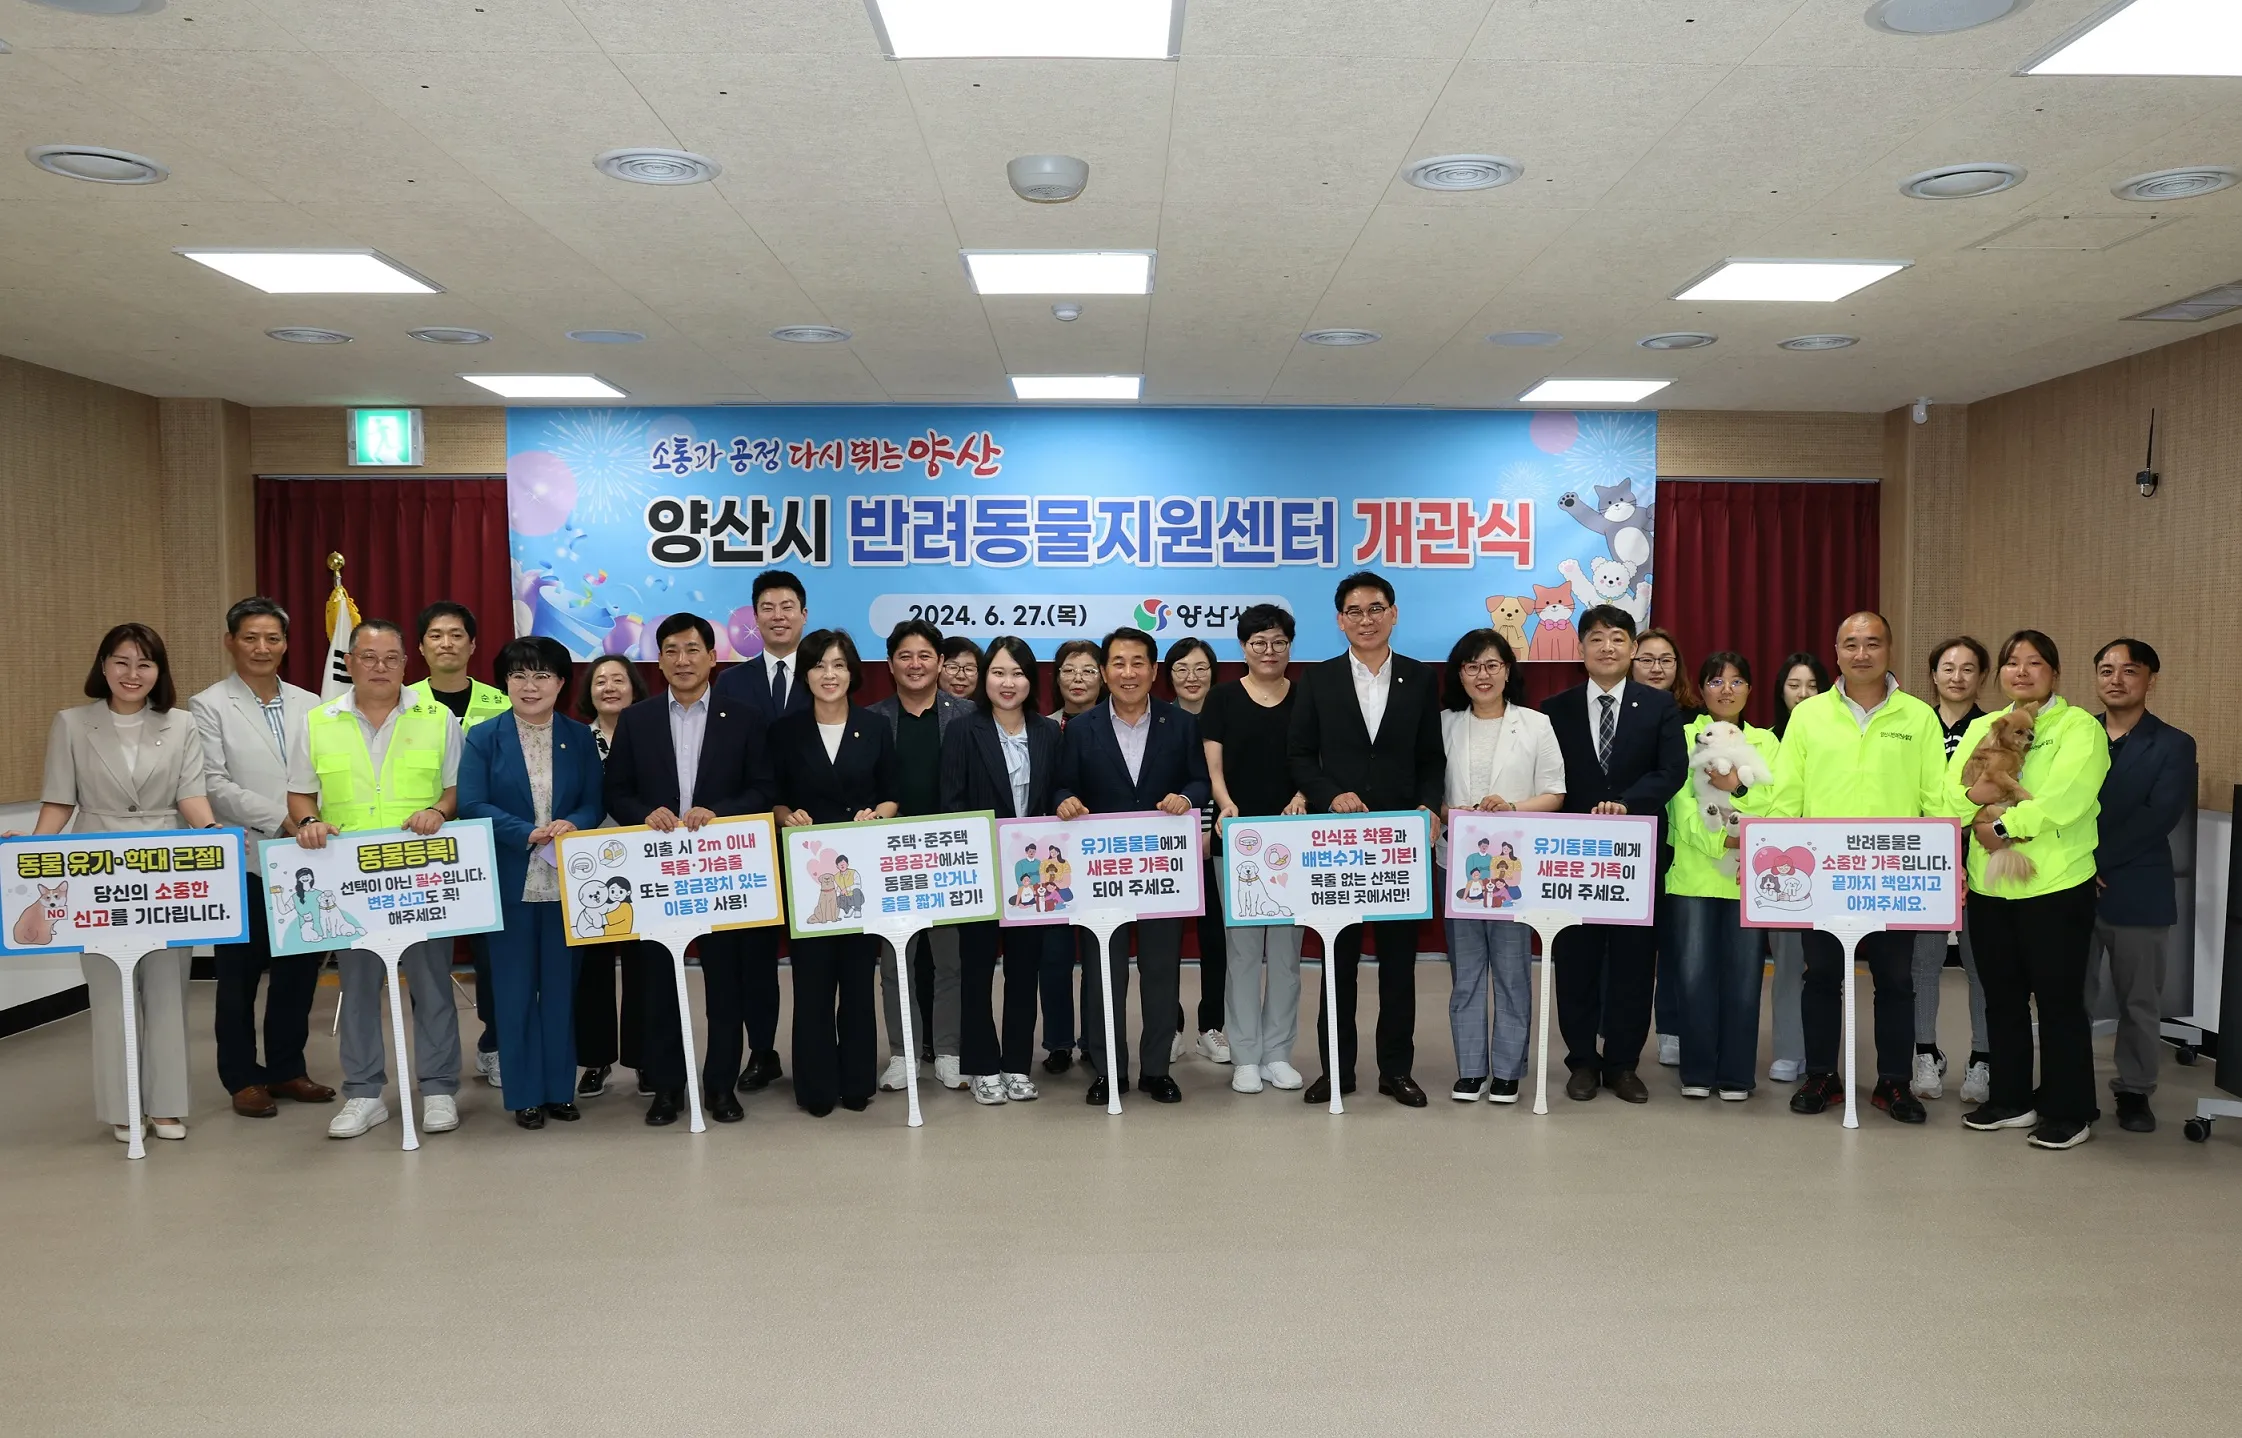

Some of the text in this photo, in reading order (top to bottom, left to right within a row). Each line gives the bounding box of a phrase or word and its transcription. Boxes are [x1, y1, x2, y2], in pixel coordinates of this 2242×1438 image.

[652, 429, 1001, 479] 소통과 공정 다시 뛰는 양산
[647, 498, 1534, 567] 양산시 반려동물지원센터 개관식
[909, 604, 1087, 628] 2024. 6. 27.(목)
[644, 833, 756, 858] 외출 시 2m 이내
[887, 829, 968, 850] 주택·준주택
[1081, 834, 1187, 855] 유기동물들에게
[1311, 827, 1407, 847] 인식표 착용과
[1534, 837, 1641, 858] 유기동물들에게
[1847, 834, 1921, 851] 반려동물은
[18, 846, 224, 878] 동물 유기·학대 근절!
[357, 837, 459, 873] 동물등록!
[661, 854, 743, 876] 목줄·가슴줄
[879, 851, 978, 872] 공용공간에서는
[1301, 847, 1417, 868] 배변수거는 기본!
[1822, 855, 1952, 871] 소중한 가족입니다.
[1087, 856, 1184, 877] 새로운 가족이
[1537, 860, 1635, 880] 새로운 가족이
[340, 868, 486, 896] 선택이 아닌 필수입니다.
[640, 872, 768, 899] 또는 잠금장치 있는
[884, 869, 977, 892] 동물을 안거나
[1092, 878, 1180, 898] 되어 주세요.
[1311, 870, 1410, 888] 목줄 없는 산책은
[1832, 875, 1942, 892] 끝까지 책임지고
[94, 881, 209, 903] 당신의 소중한
[368, 888, 460, 910] 변경 신고도 꼭!
[881, 888, 983, 912] 줄을 짧게 잡기!
[1311, 888, 1410, 906] 허용된 곳에서만!
[1541, 883, 1630, 902] 되어 주세요.
[47, 909, 65, 918] NO
[664, 894, 747, 916] 이동장 사용!
[1847, 896, 1927, 912] 아껴주세요.
[73, 904, 230, 928] 신고를 기다립니다.
[388, 906, 447, 925] 해주세요!
